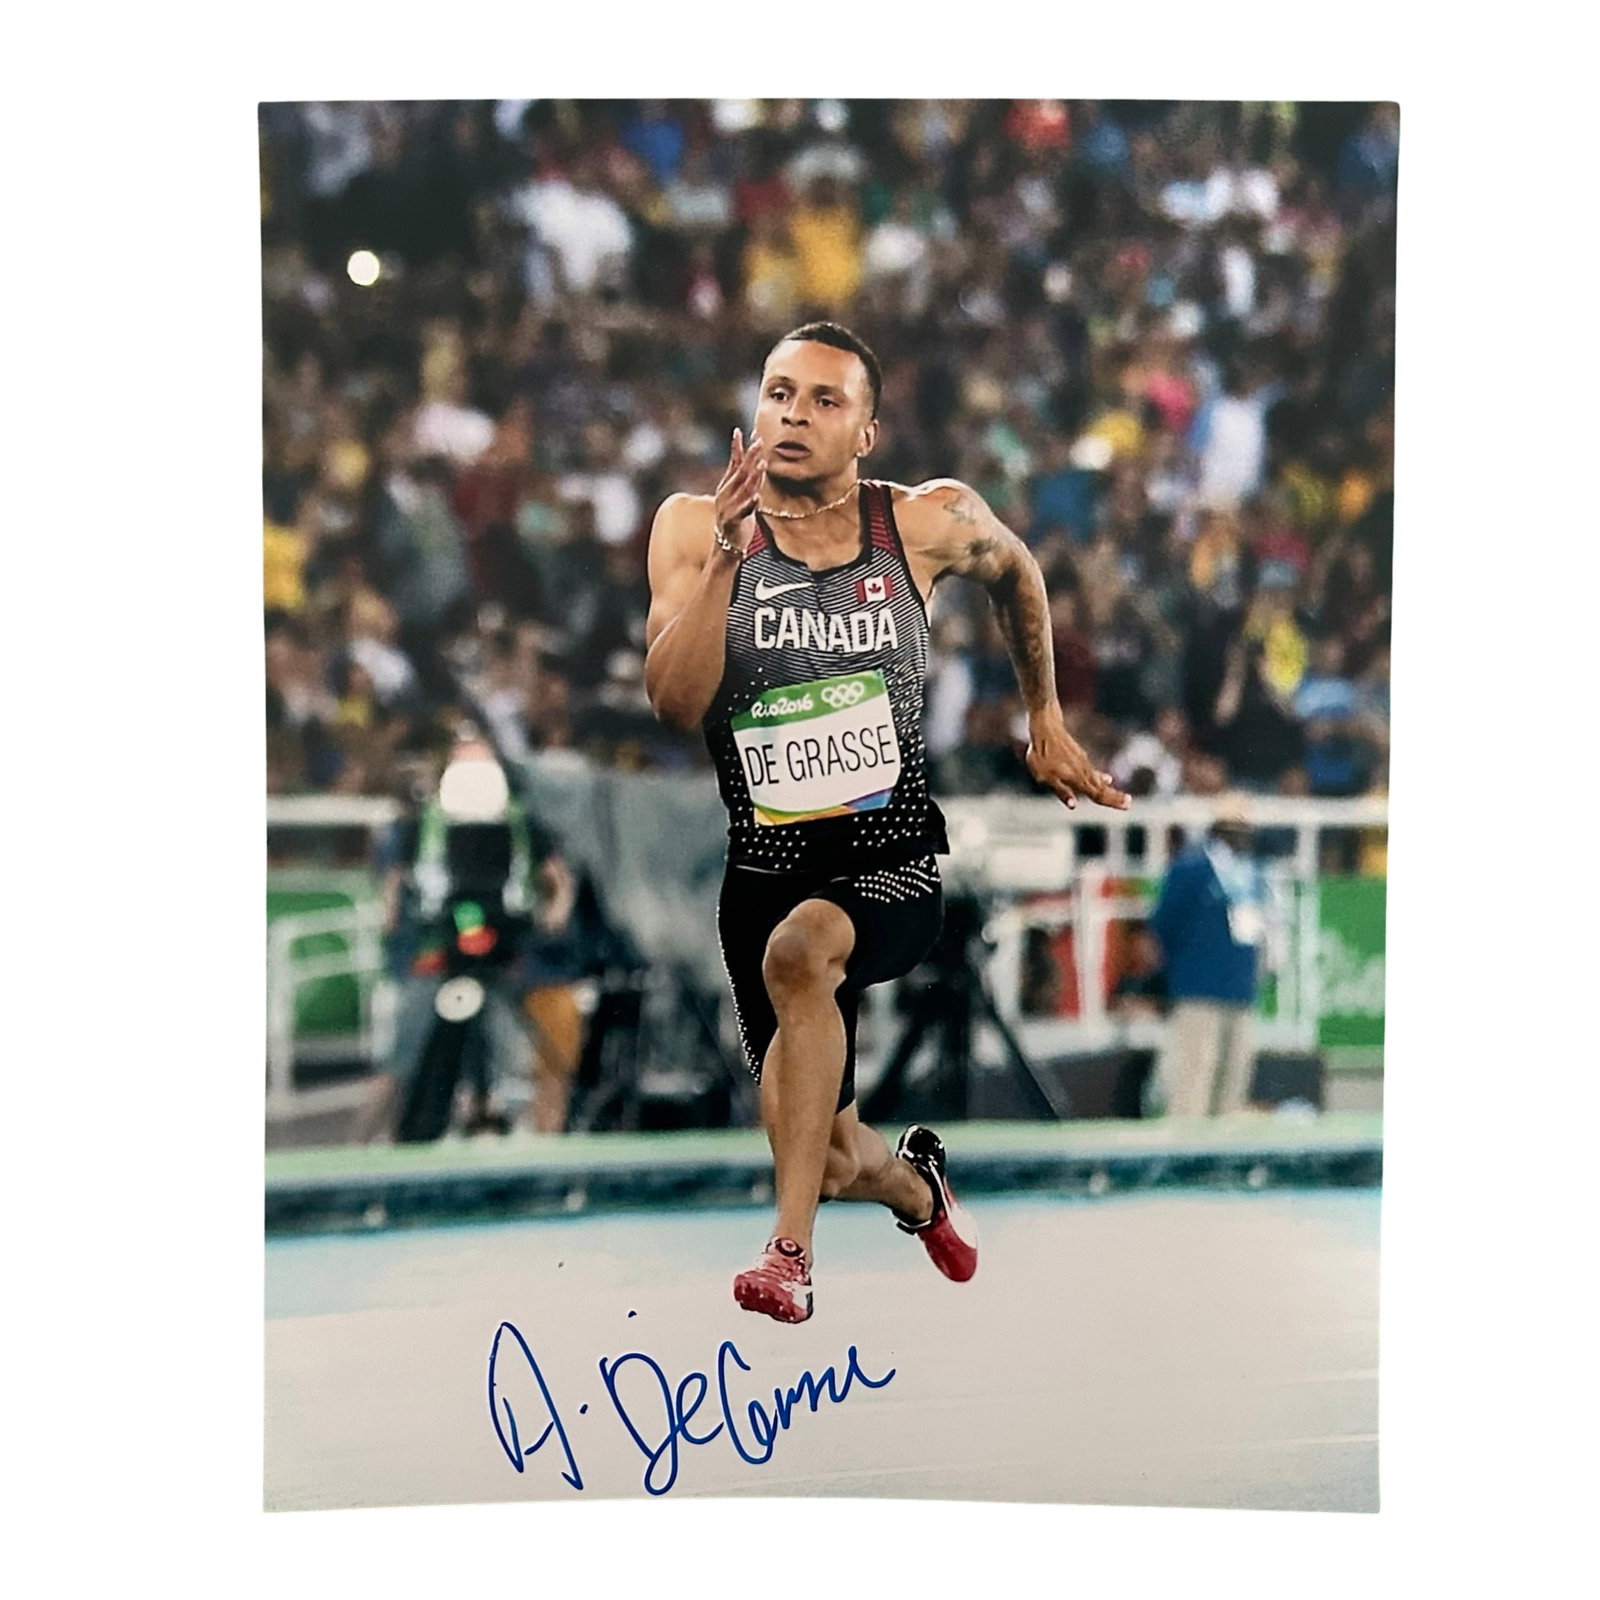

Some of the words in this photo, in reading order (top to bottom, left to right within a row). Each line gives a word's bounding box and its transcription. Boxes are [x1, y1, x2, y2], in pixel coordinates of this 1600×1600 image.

[753, 607, 899, 653] CANADA
[751, 693, 815, 719] Rio2016
[743, 743, 780, 787] DE
[786, 724, 896, 782] GRASSE
